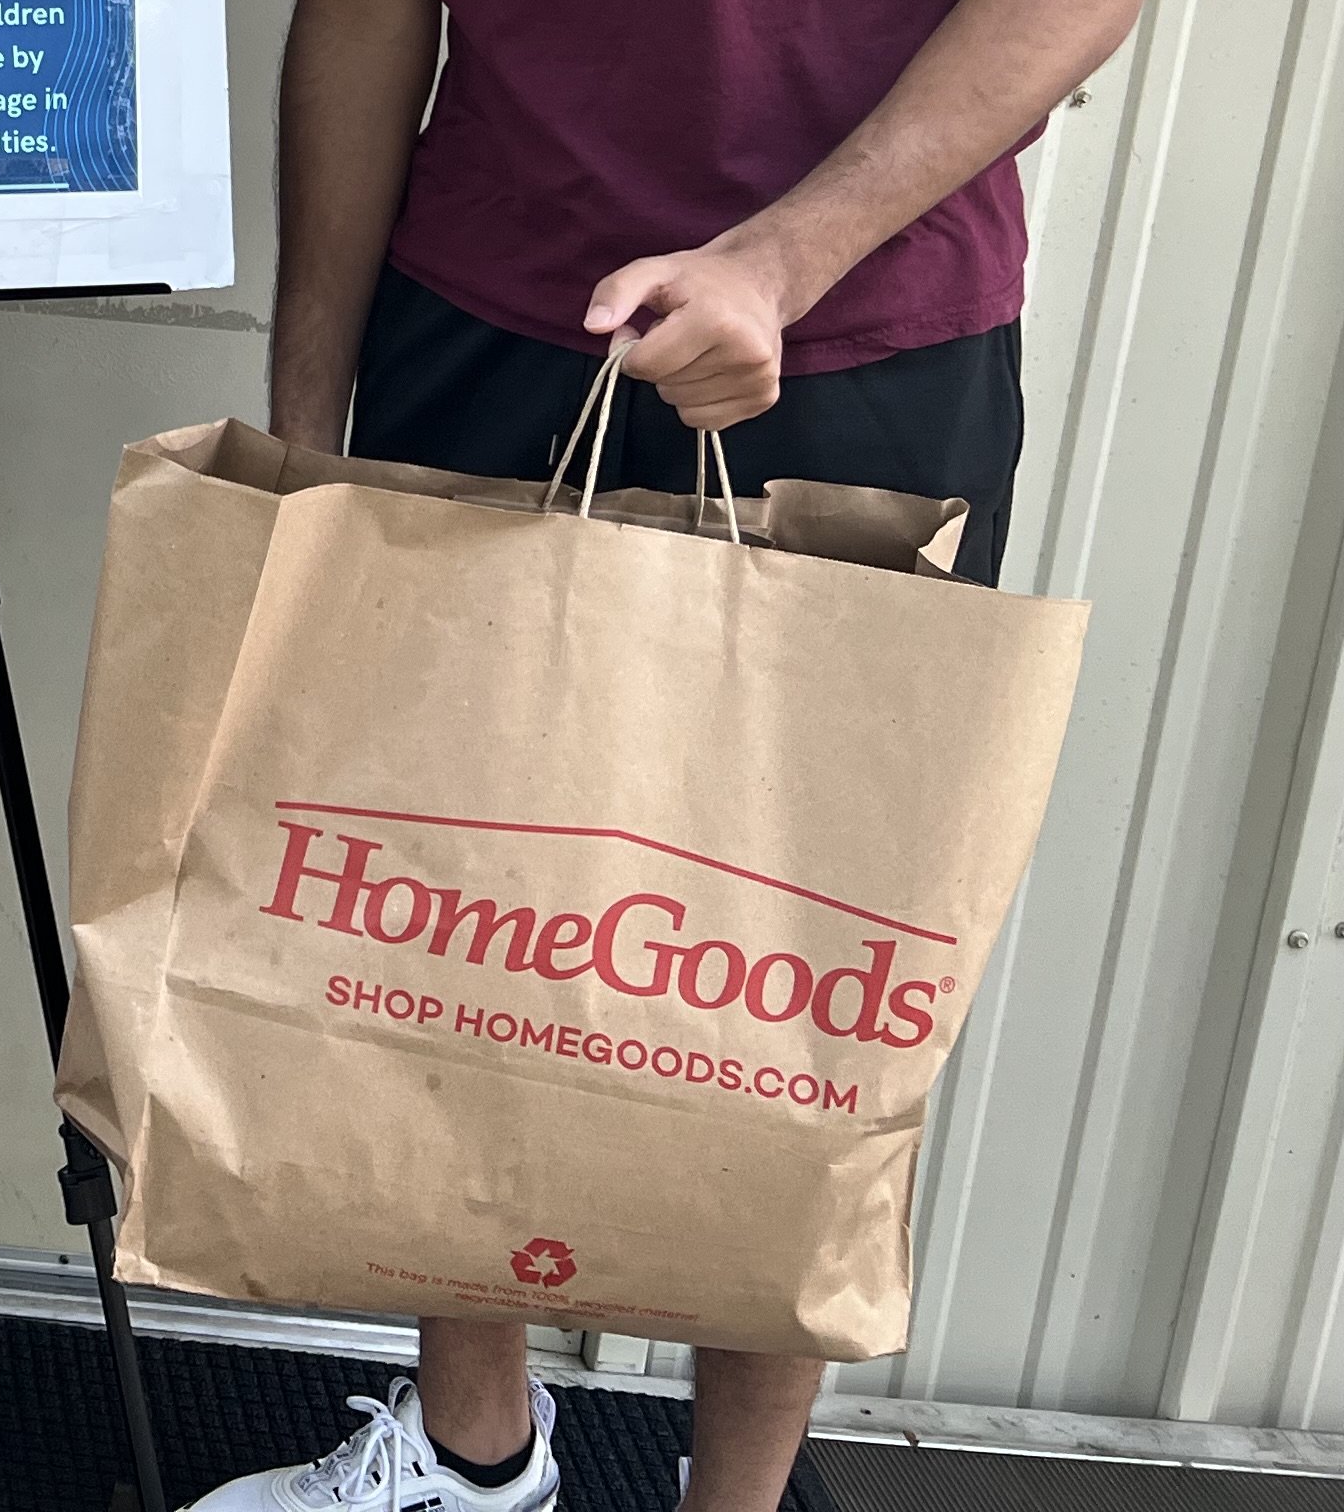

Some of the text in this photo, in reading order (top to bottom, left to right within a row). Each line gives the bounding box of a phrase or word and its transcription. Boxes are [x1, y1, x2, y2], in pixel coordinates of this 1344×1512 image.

[12, 44, 45, 74] by
[45, 87, 68, 112] in
[325, 974, 862, 1114] SHOP HOMEGOODS.COM
[367, 1262, 395, 1278] This
[399, 1269, 427, 1284] bag
[431, 1276, 443, 1285] is
